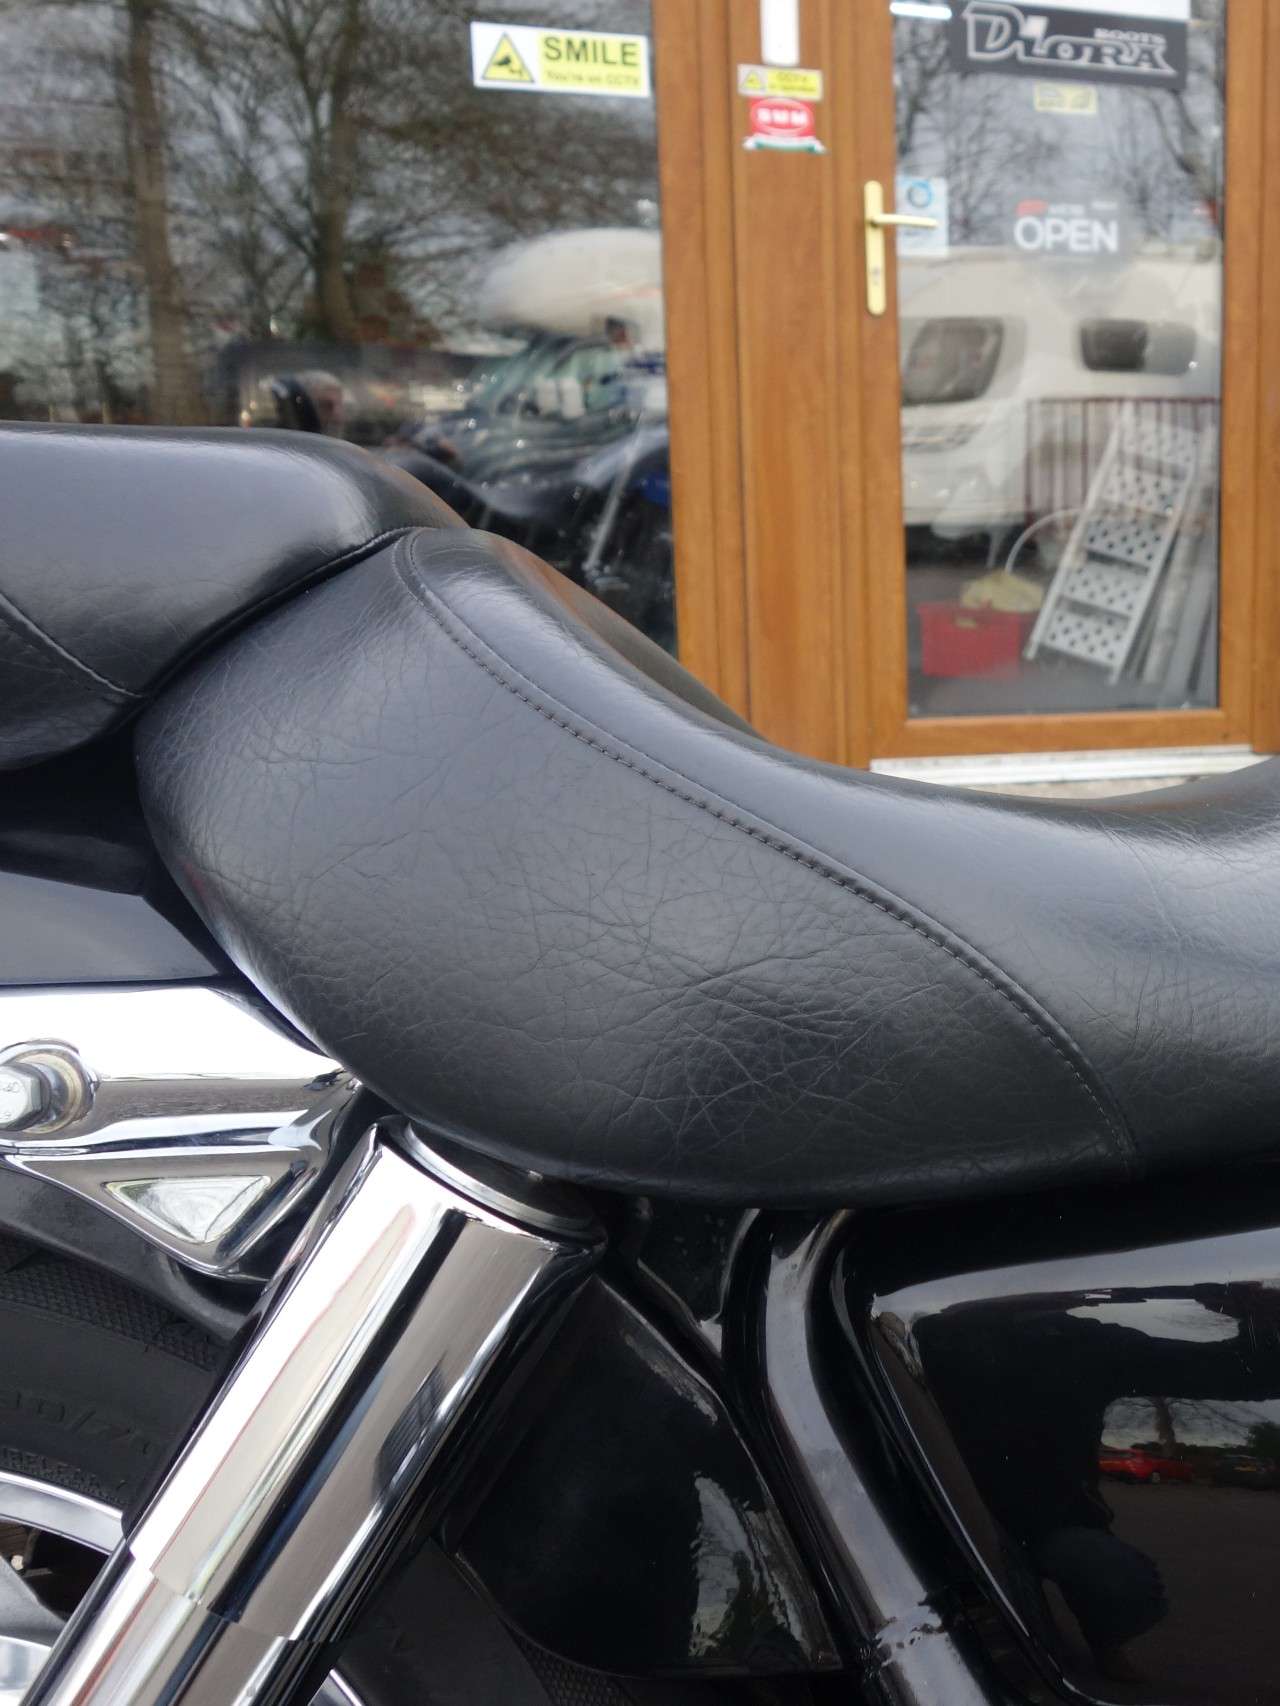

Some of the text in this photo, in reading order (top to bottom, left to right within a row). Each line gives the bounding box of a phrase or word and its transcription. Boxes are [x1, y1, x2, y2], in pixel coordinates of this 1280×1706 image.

[544, 36, 640, 67] SMILE
[606, 75, 640, 86] CCTV
[1014, 216, 1118, 253] OPEN
